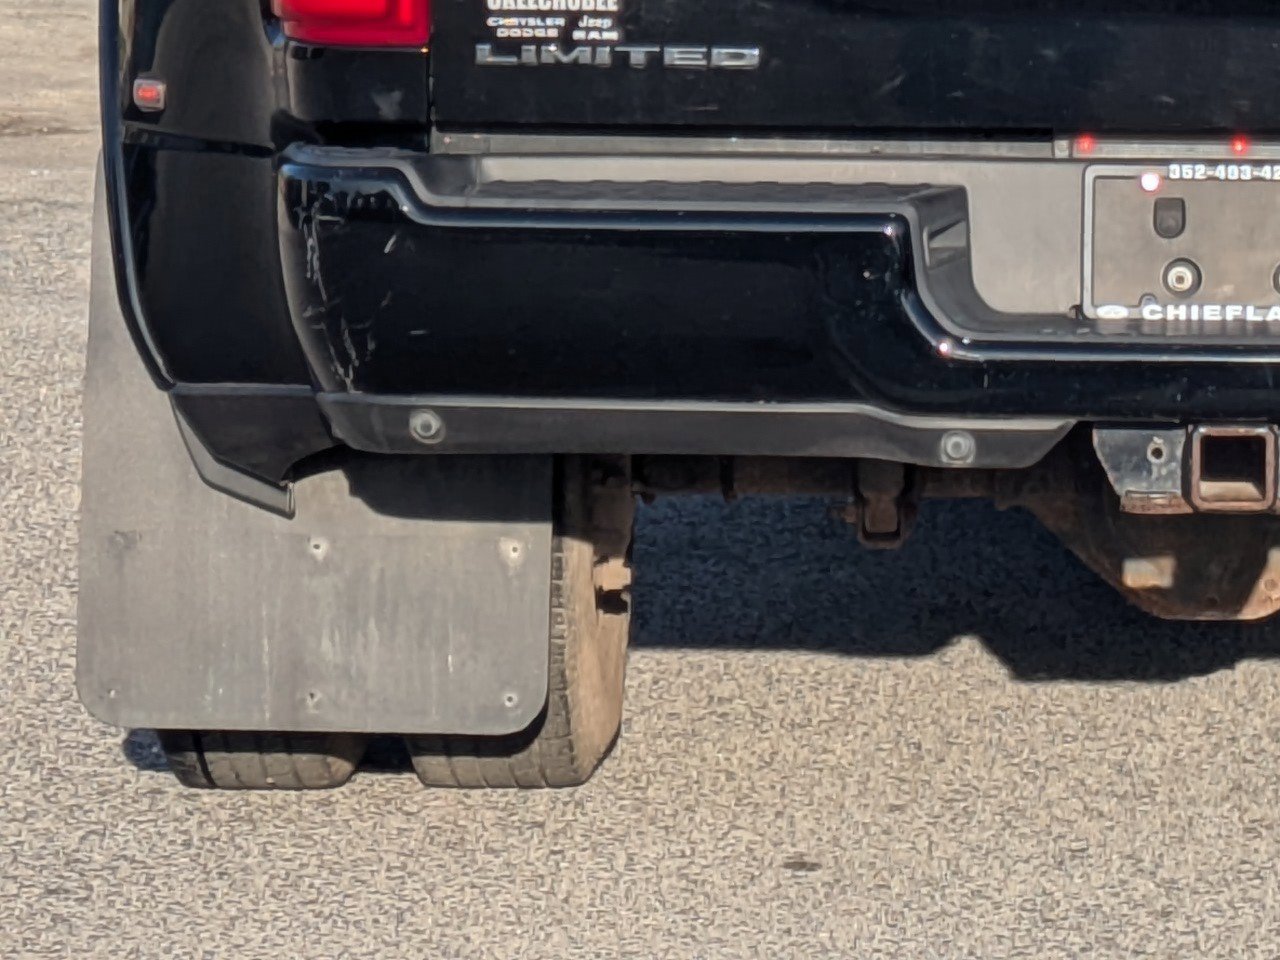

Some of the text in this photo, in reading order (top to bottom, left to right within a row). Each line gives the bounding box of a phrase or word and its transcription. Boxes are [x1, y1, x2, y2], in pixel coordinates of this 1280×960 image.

[486, 15, 613, 29] CHRYSLER Jeep
[496, 27, 560, 38] DODGE
[474, 43, 761, 69] LIMITED
